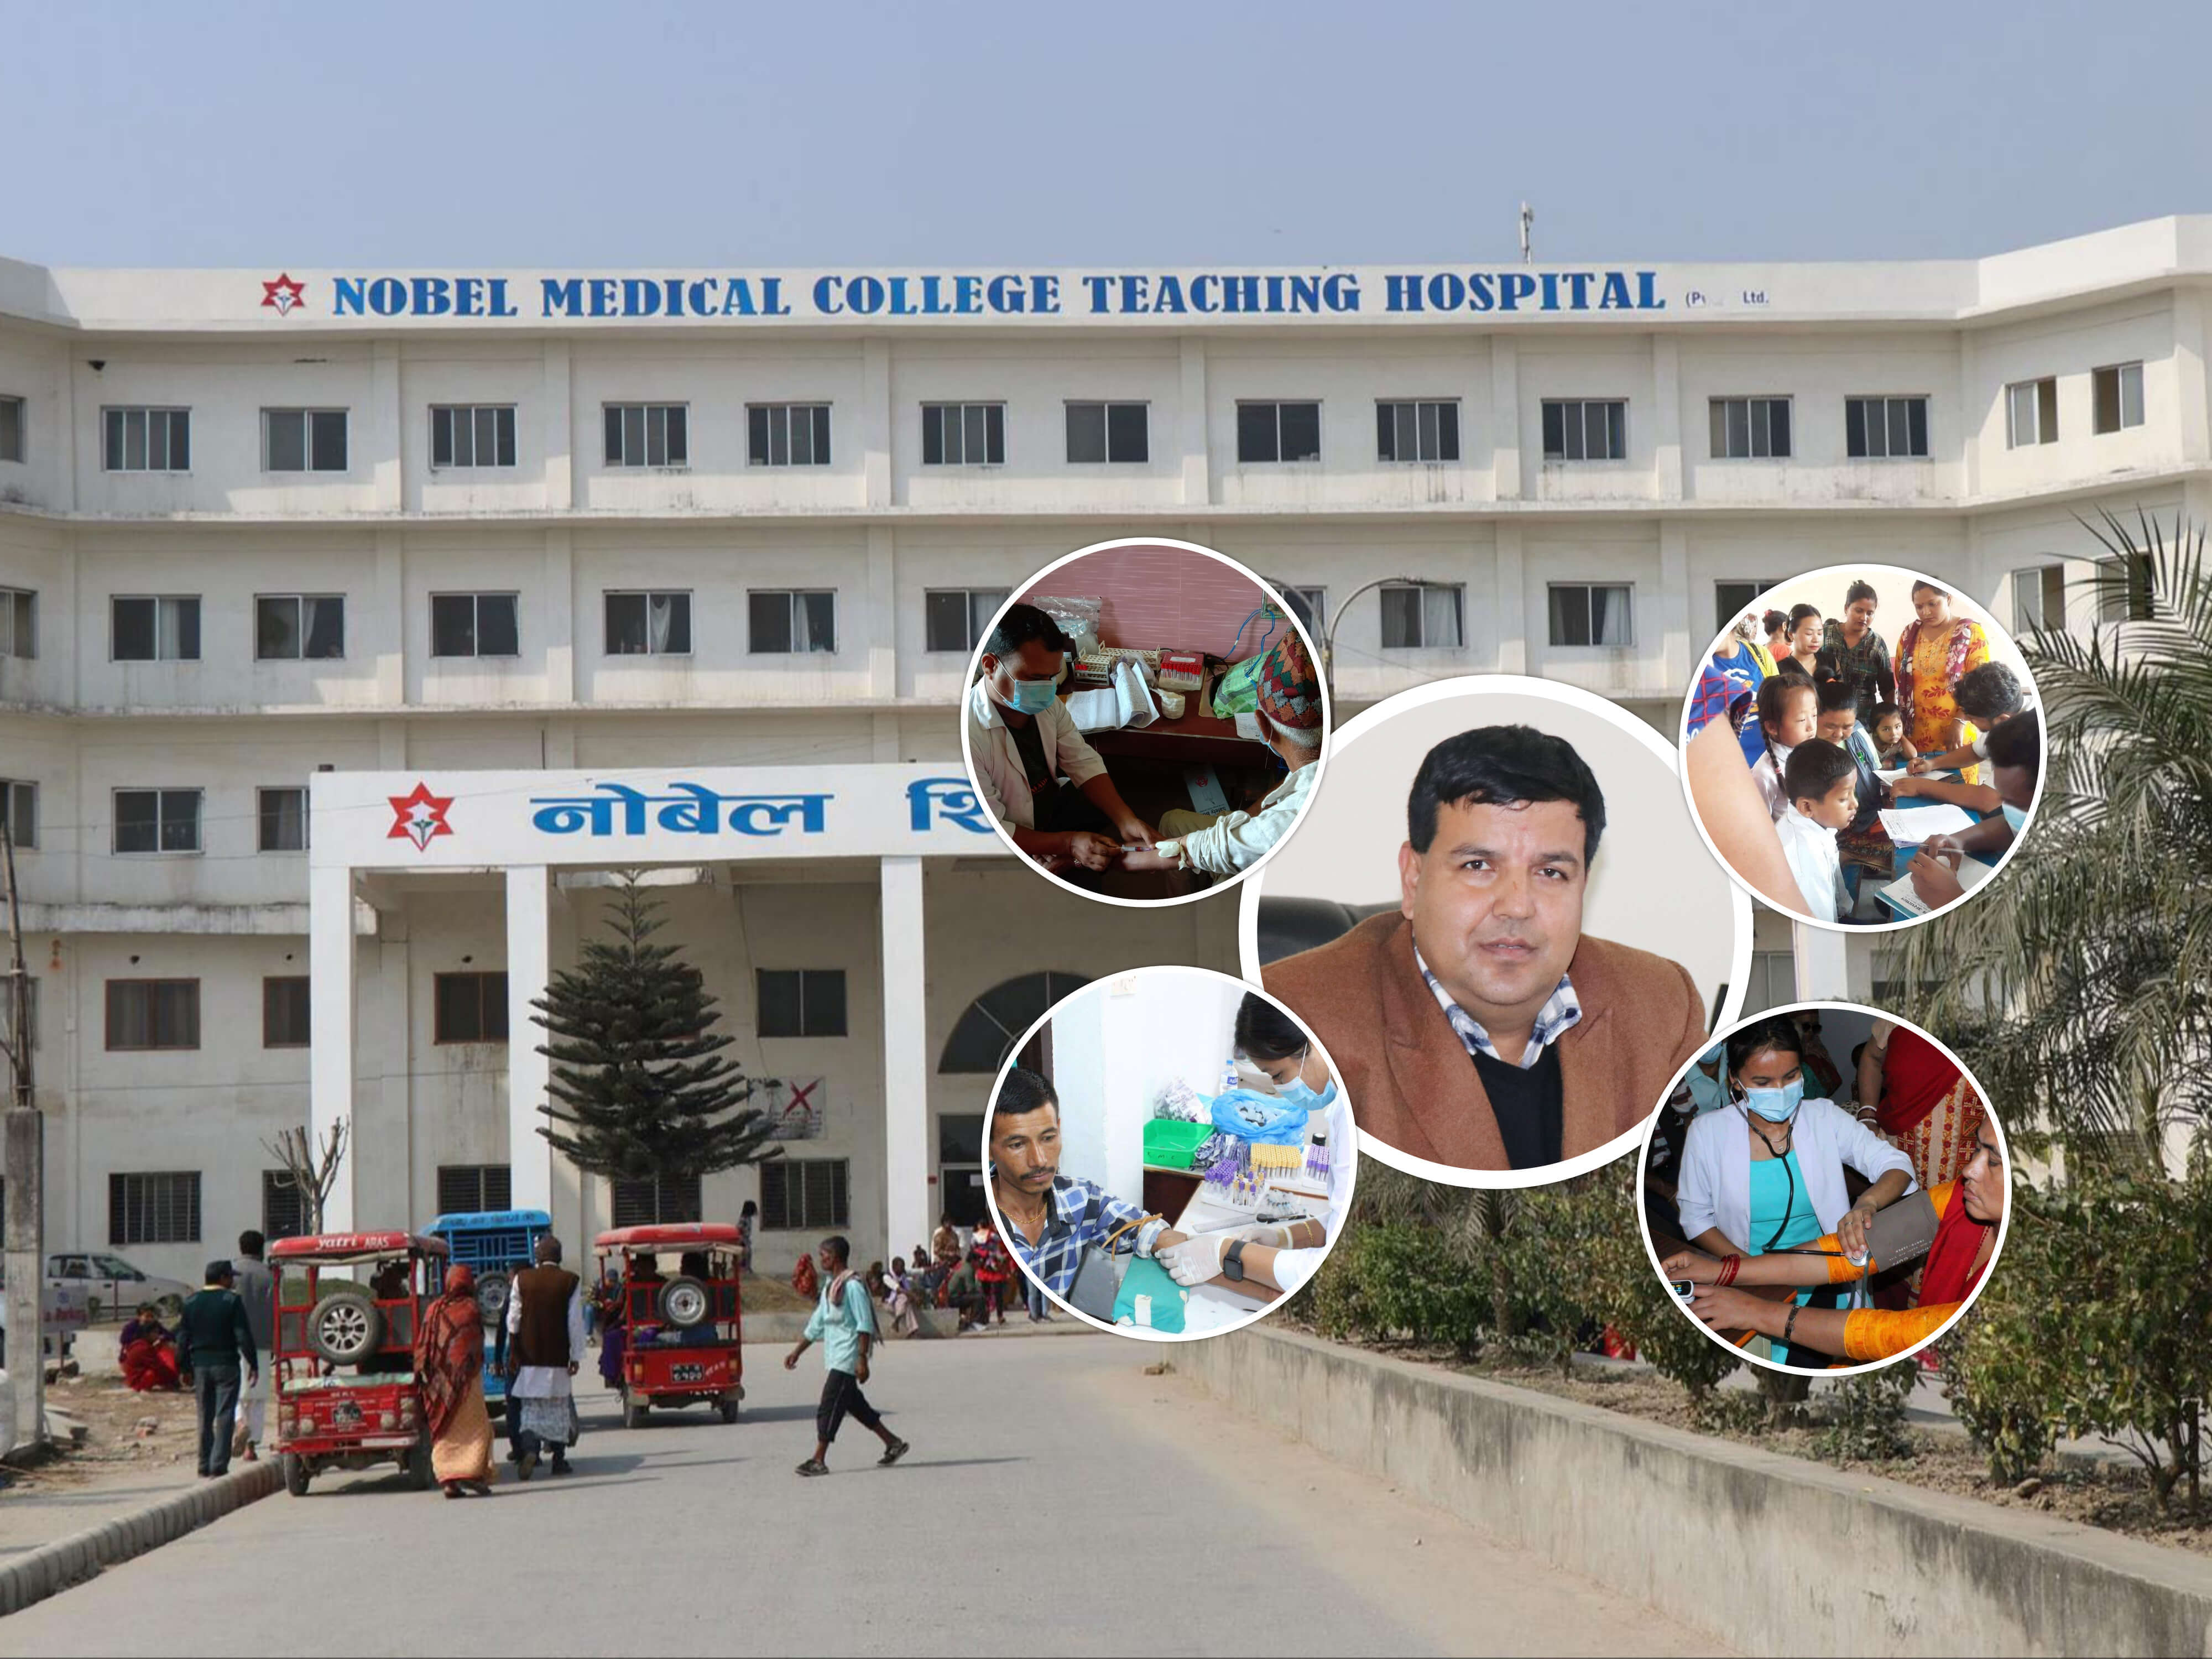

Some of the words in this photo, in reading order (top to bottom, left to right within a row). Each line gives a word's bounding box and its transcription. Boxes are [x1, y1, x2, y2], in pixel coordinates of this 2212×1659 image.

[333, 277, 518, 316] NOBEL
[542, 276, 792, 317] MEDICAL
[812, 275, 1060, 315] COLLEGE
[1083, 275, 1361, 314] TEACHING
[1385, 272, 1666, 312] HOSPITAL
[530, 782, 834, 836] नोबेल
